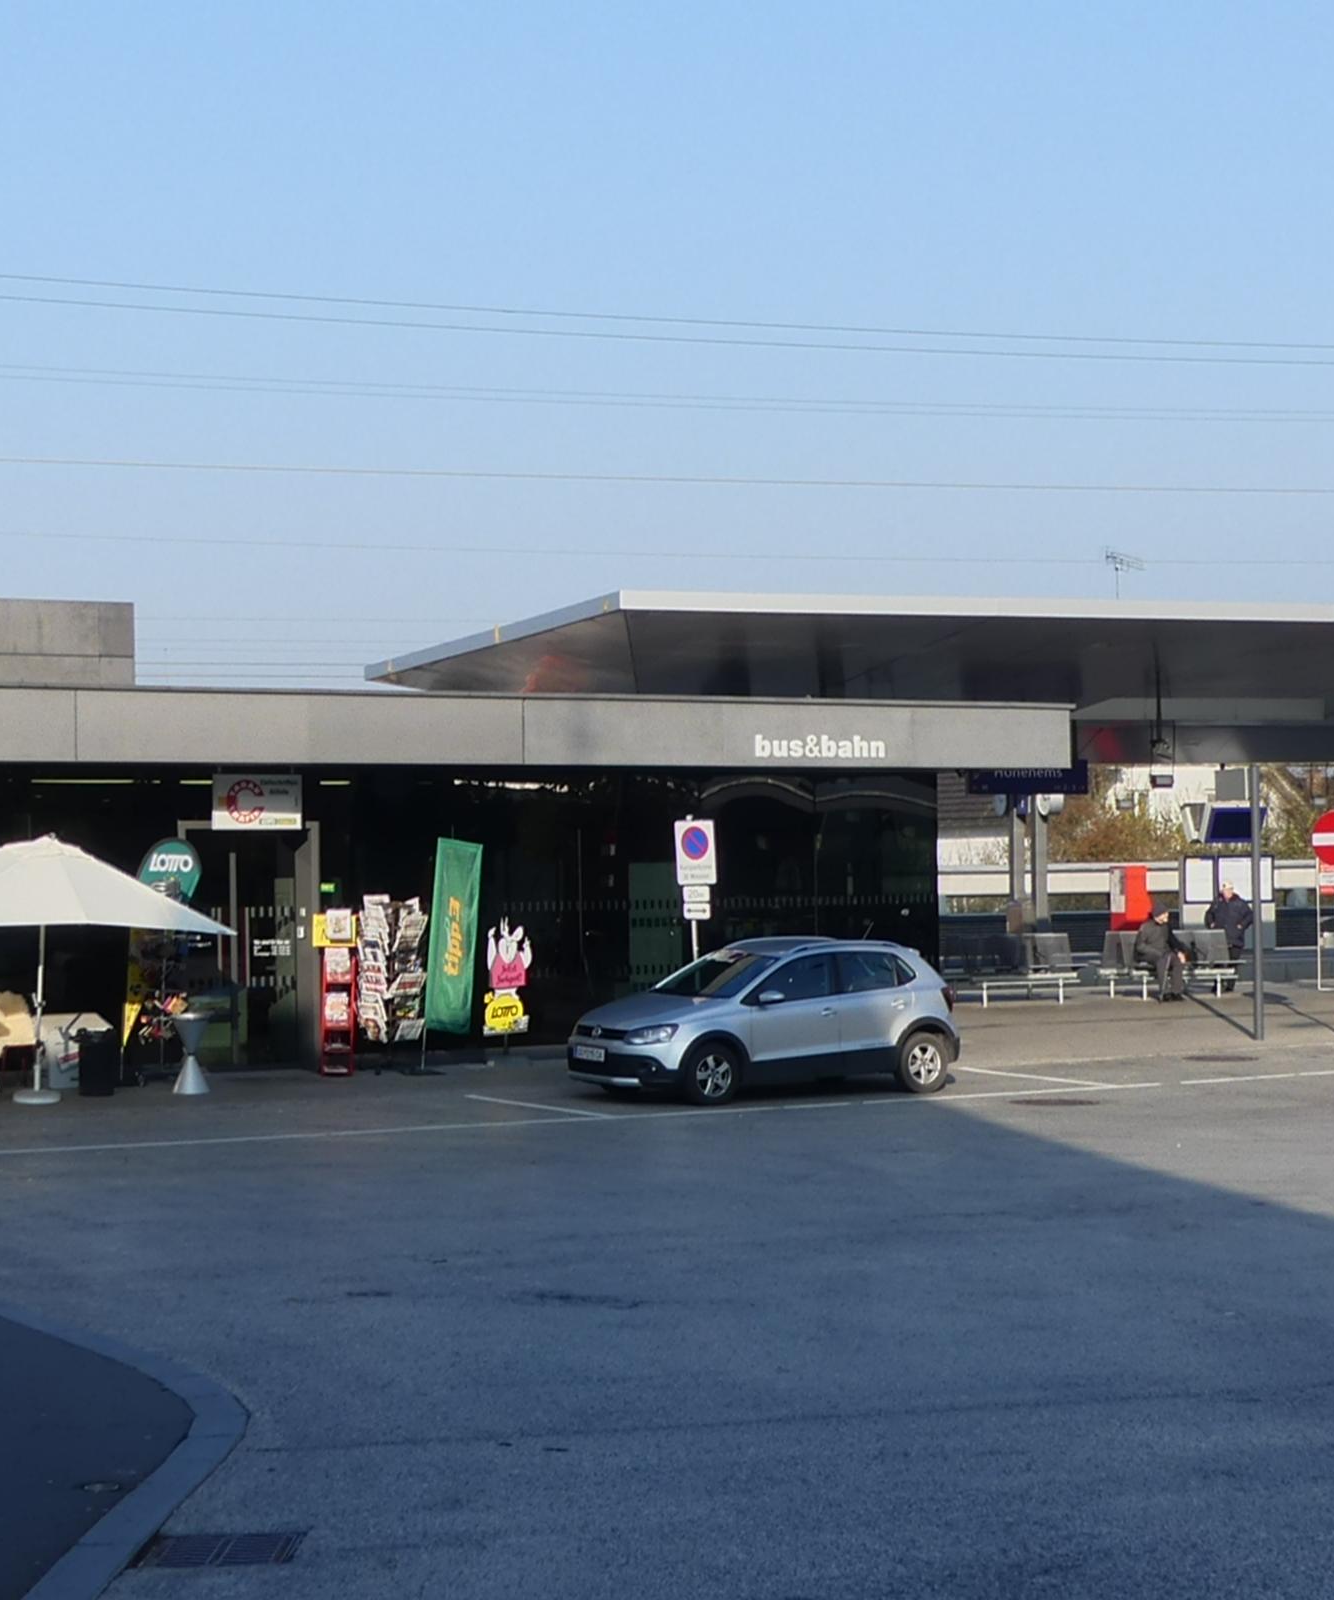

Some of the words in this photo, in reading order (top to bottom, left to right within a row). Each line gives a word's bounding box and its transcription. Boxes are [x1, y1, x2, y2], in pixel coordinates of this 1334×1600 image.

[754, 733, 886, 759] bus&bahn
[149, 852, 194, 872] LOTTO
[491, 1004, 518, 1019] LOTTO
